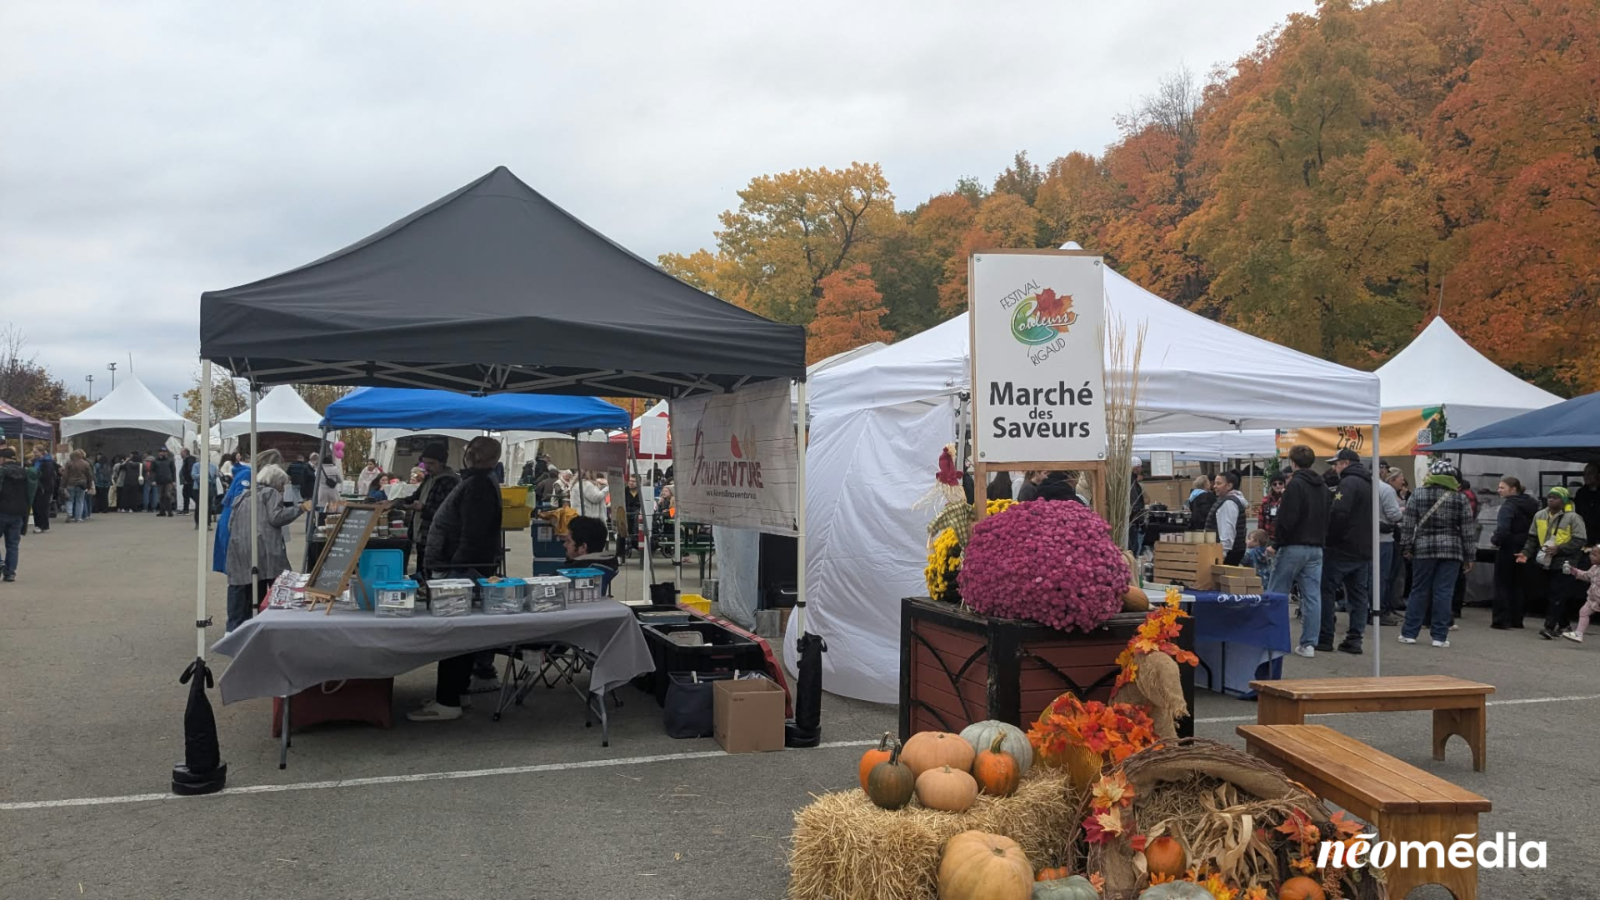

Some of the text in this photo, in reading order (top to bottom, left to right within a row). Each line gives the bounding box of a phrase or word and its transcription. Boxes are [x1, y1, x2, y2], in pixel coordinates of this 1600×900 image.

[1000, 279, 1040, 310] FESTIVAL
[1030, 337, 1066, 366] RIGAUD
[989, 381, 1093, 406] Marché
[1029, 407, 1053, 420] des
[993, 416, 1090, 439] Saveurs
